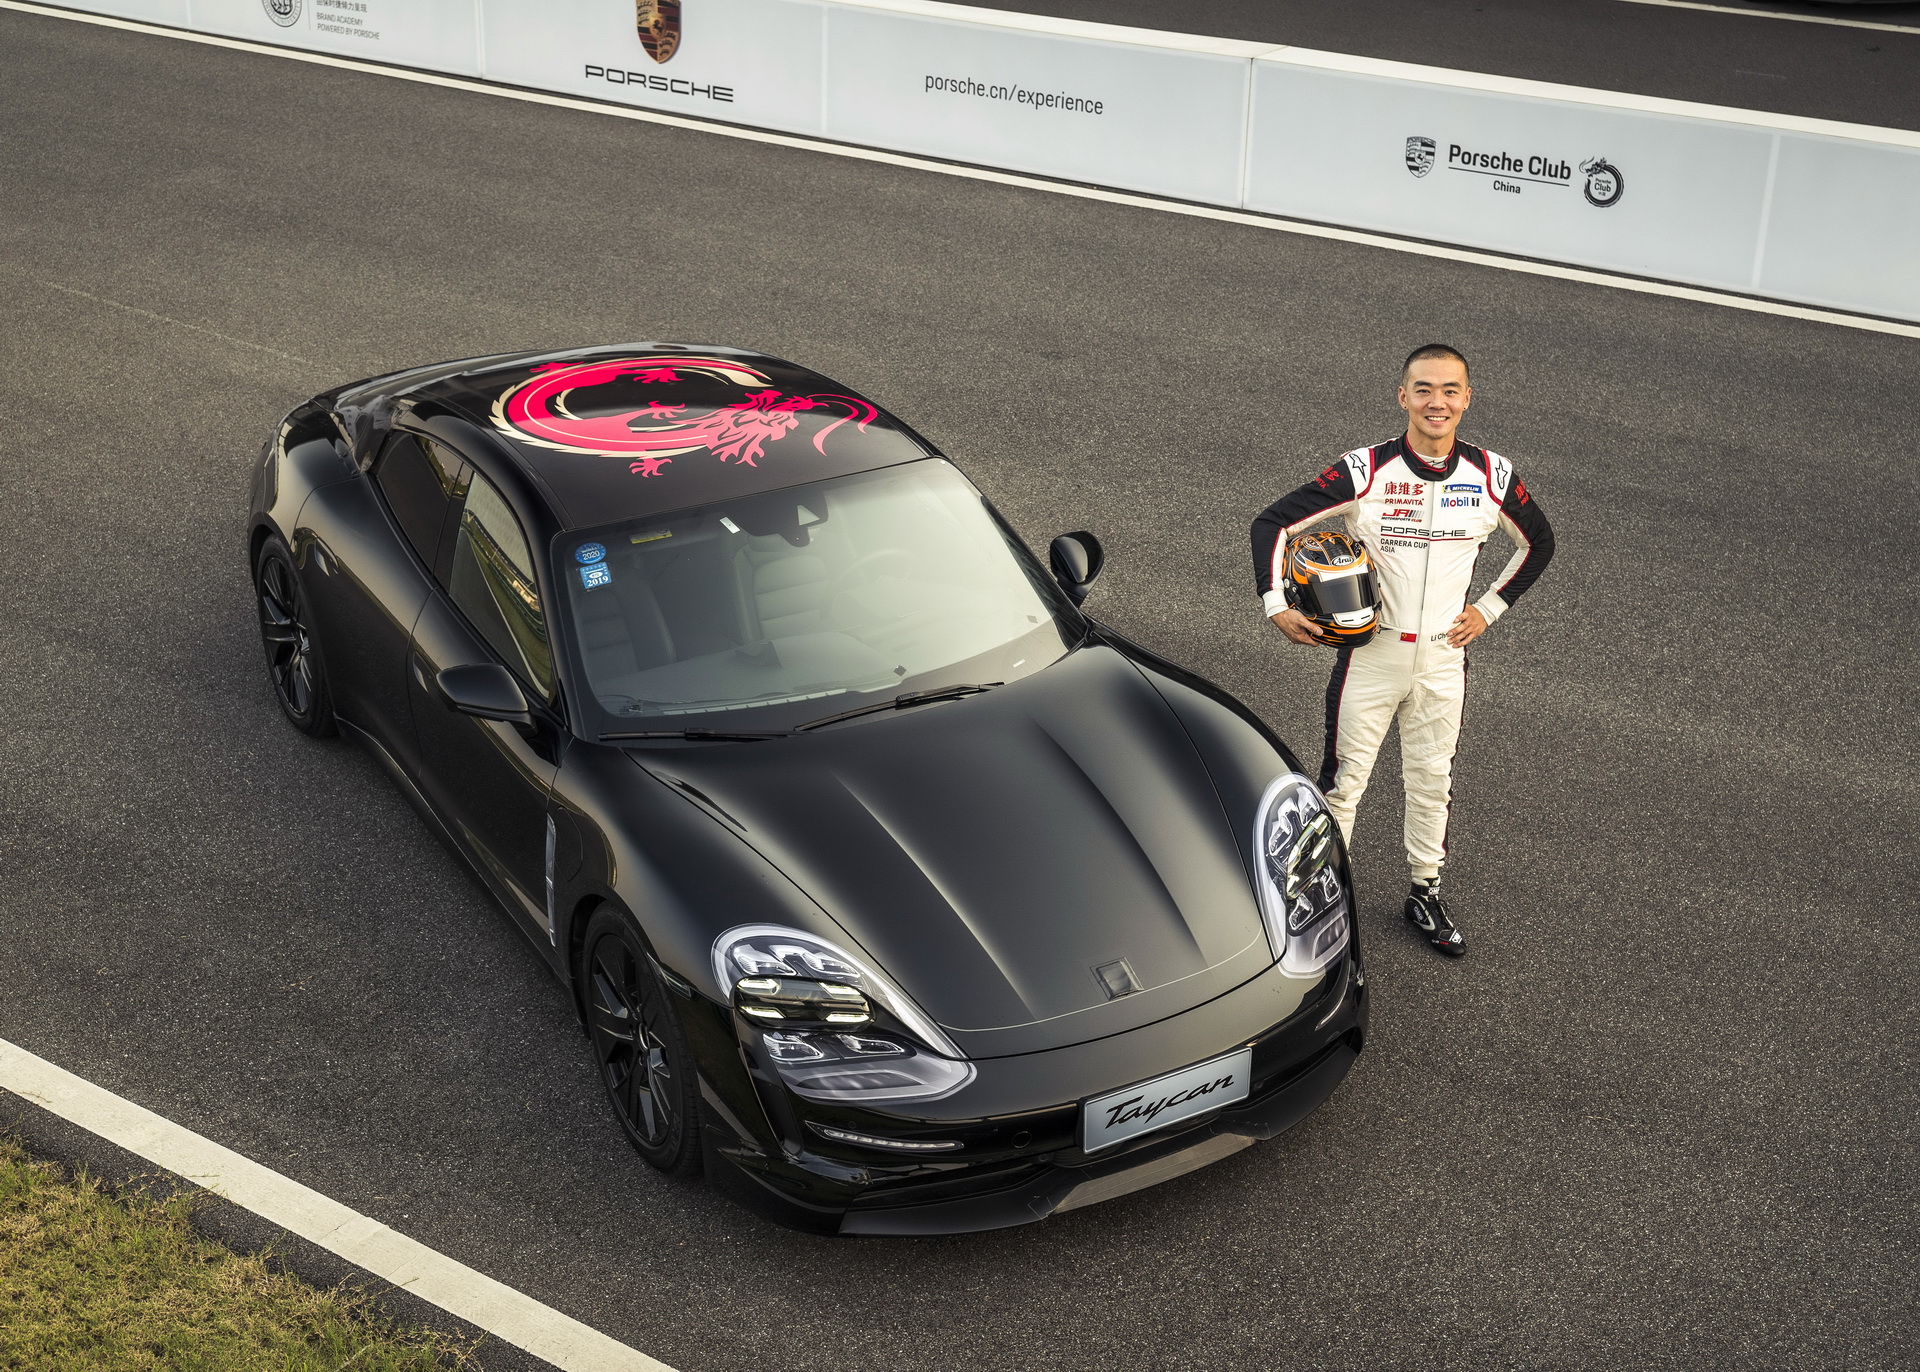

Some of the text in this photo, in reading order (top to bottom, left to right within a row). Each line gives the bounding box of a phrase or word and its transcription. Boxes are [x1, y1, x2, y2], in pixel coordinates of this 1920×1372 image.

[316, 12, 363, 26] BRAND ACADEMY
[317, 23, 380, 40] POWERED BY PORSCHE
[585, 64, 734, 103] PORSCHE
[925, 75, 1104, 115] porsche.cn/experience
[1448, 144, 1572, 180] Porsche Club
[1493, 180, 1521, 194] China
[1594, 182, 1611, 192] Club
[1384, 481, 1424, 495] 康维多
[1384, 498, 1423, 506] PRIMAVITA
[1440, 496, 1469, 507] Mobil
[1380, 525, 1466, 538] PORSCHE
[1380, 538, 1428, 549] CARRERA CUP
[1380, 545, 1396, 553] ASIA
[582, 550, 600, 560] 2020
[587, 575, 609, 587] 2019
[1104, 1074, 1235, 1130] Taycan
